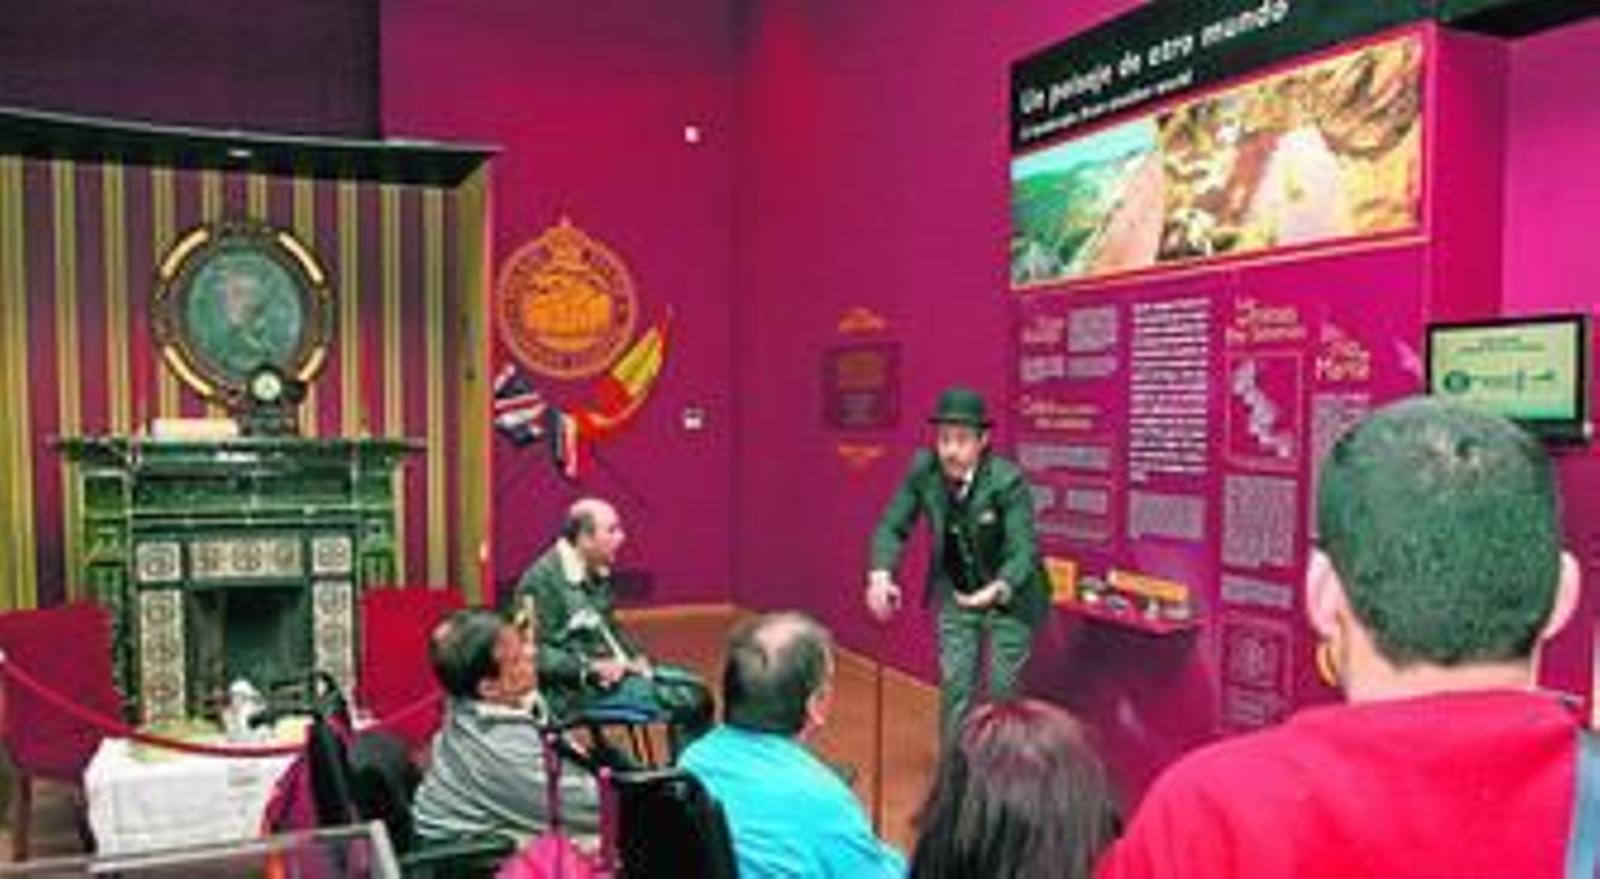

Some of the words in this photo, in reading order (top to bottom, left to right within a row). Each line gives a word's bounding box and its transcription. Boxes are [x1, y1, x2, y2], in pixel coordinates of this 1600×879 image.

[1119, 51, 1142, 77] de
[1147, 35, 1193, 66] otro
[1201, 0, 1289, 47] mundo
